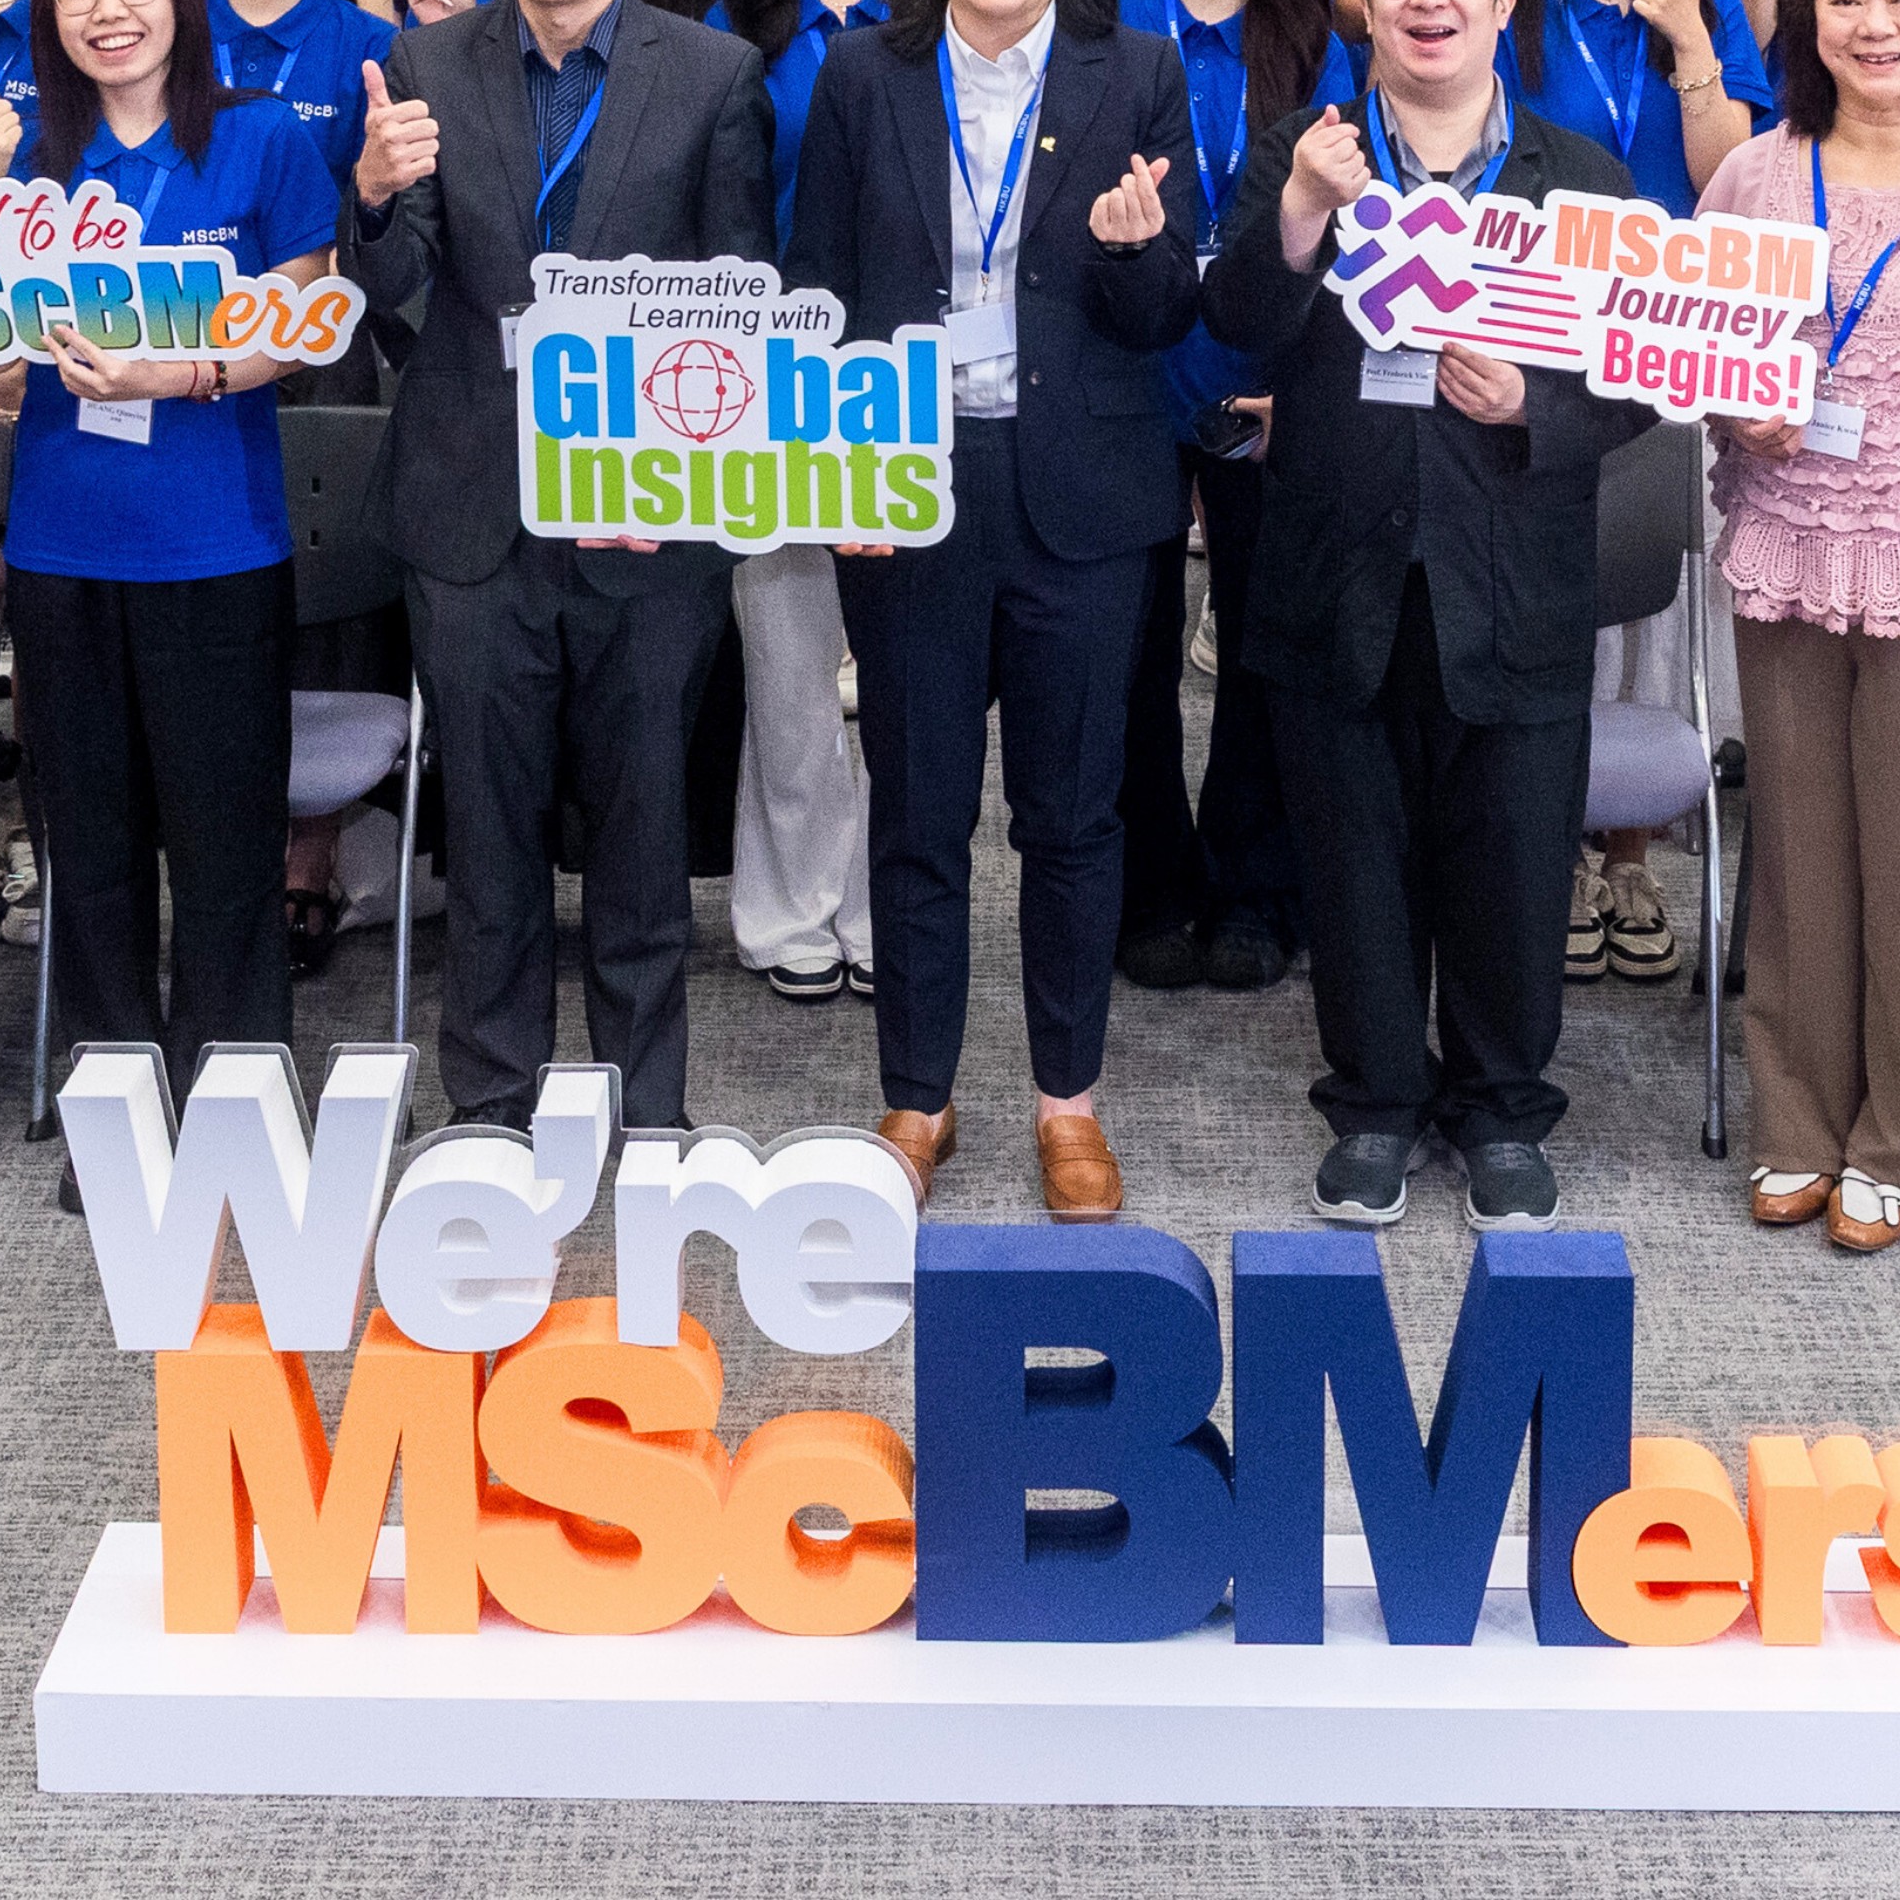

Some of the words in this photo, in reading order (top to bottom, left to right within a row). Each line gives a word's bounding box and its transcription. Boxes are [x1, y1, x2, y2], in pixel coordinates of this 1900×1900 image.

[1016, 114, 1030, 139] HKBU
[1196, 147, 1208, 172] HKBU
[1226, 149, 1241, 175] HKBU
[997, 186, 1011, 213] HKBU
[13, 193, 57, 261] to
[72, 195, 127, 251] be
[181, 226, 239, 244] MScBM
[1473, 207, 1547, 264] My
[1553, 203, 1815, 301] MScBM
[544, 267, 767, 299] Transformative
[1853, 282, 1871, 311] HKBU
[628, 302, 761, 336] Learning
[770, 304, 832, 332] with
[1597, 277, 1789, 349] Journey
[1602, 327, 1803, 410] Begins!
[534, 430, 940, 540] Insights
[60, 1050, 918, 1355] We're
